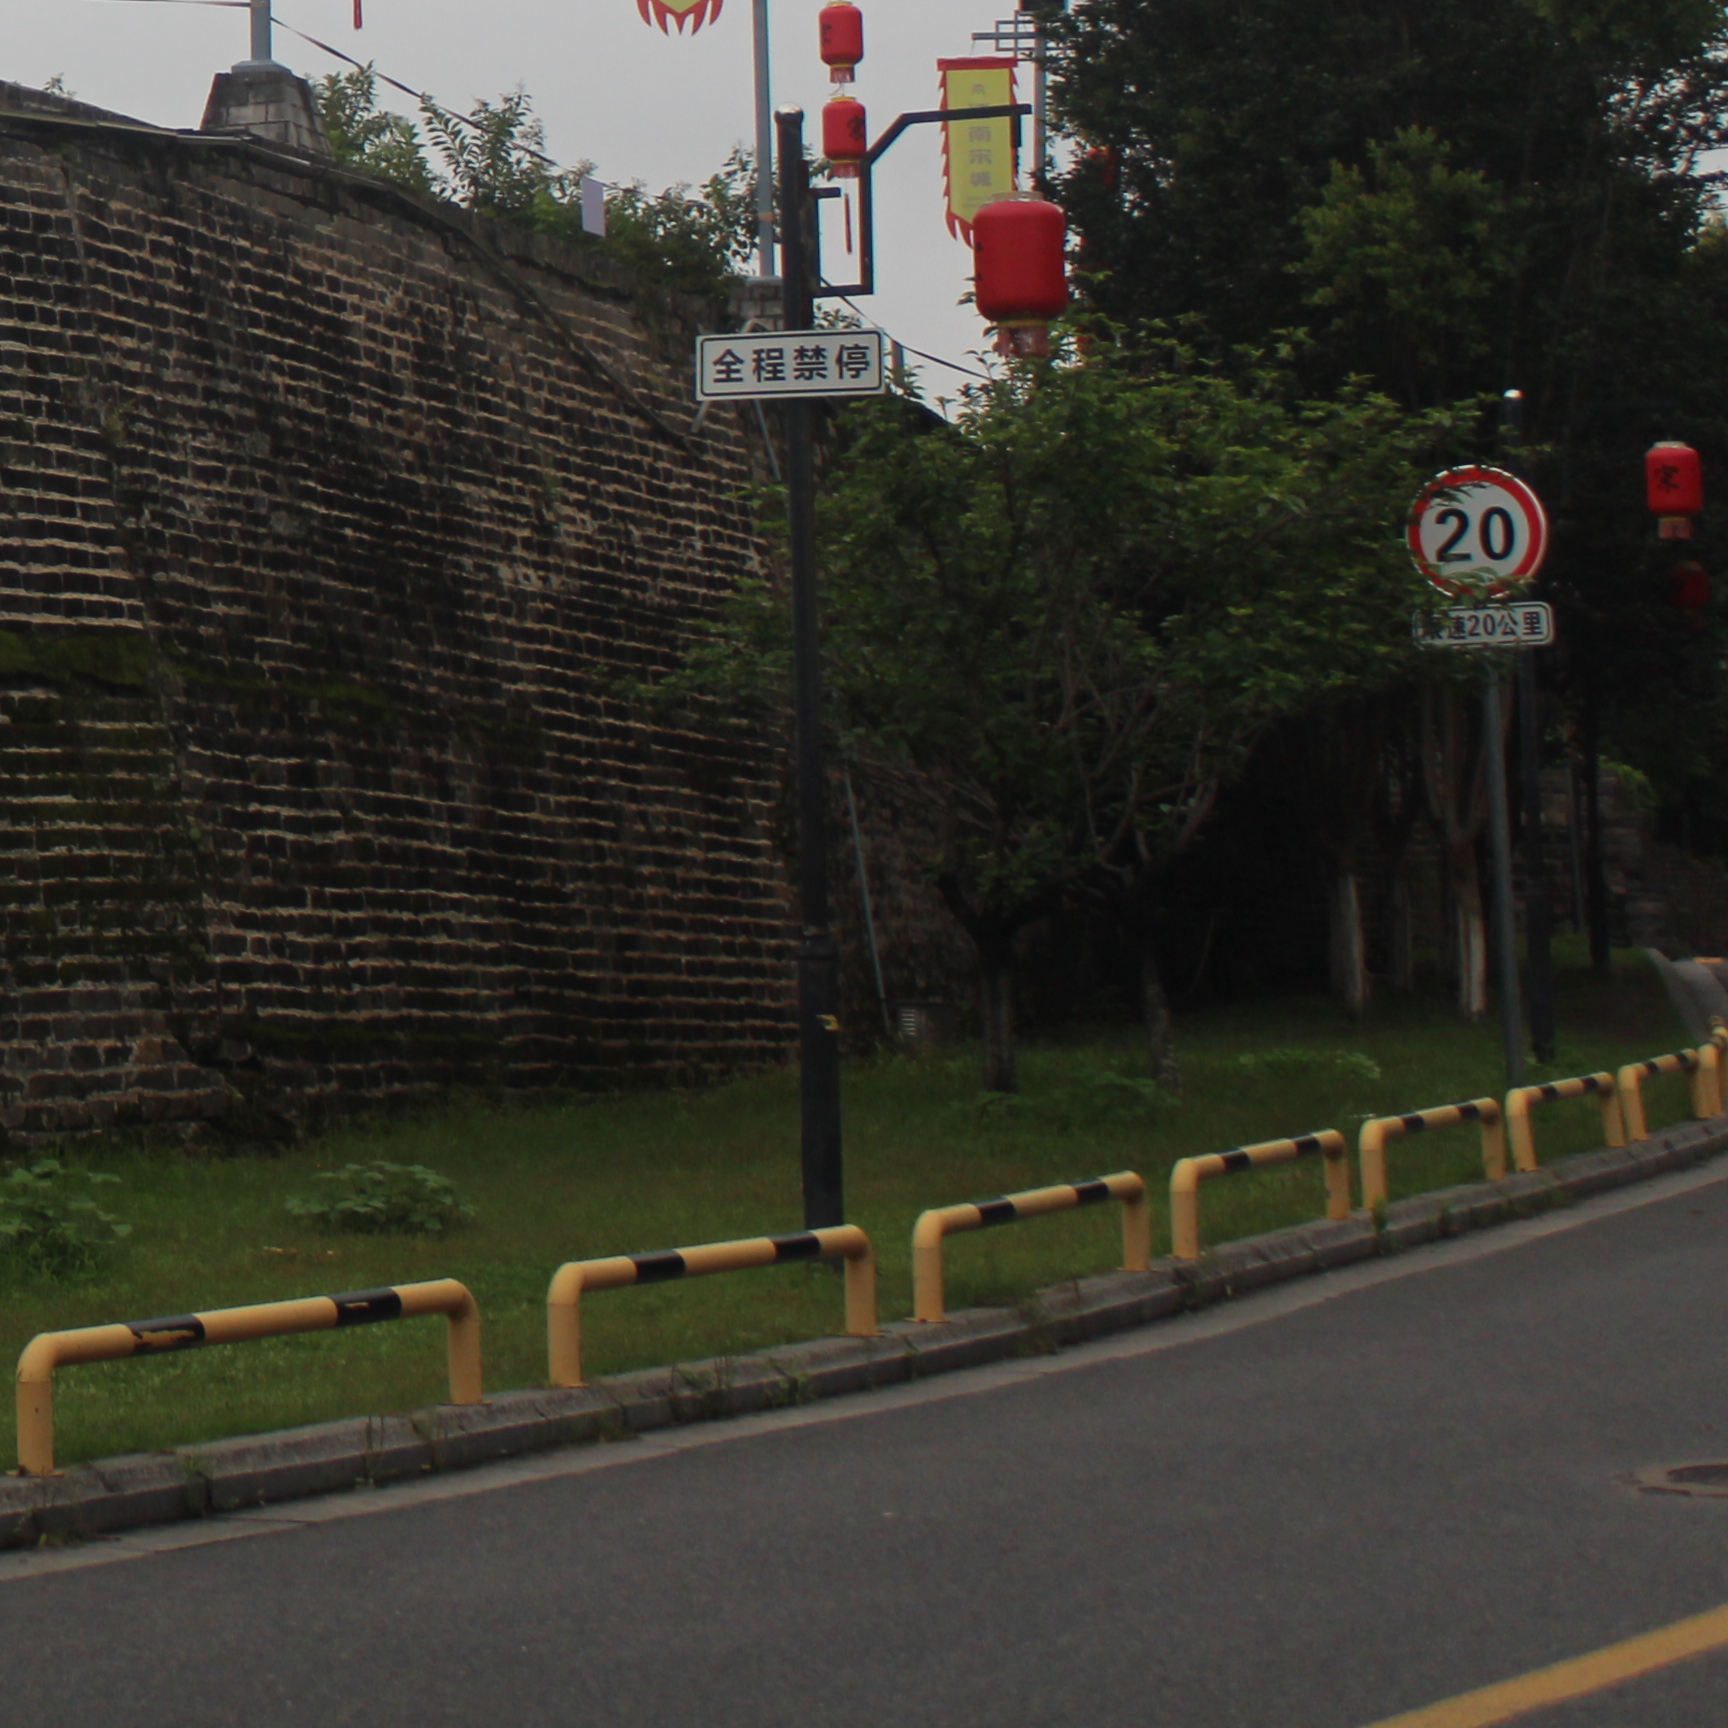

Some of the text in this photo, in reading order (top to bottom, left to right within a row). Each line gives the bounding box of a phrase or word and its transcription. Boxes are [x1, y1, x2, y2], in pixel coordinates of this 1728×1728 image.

[968, 103, 992, 187] 南宋城
[712, 343, 870, 383] 全程禁停
[1435, 506, 1516, 563] 20
[1416, 611, 1543, 640] 速20公里
